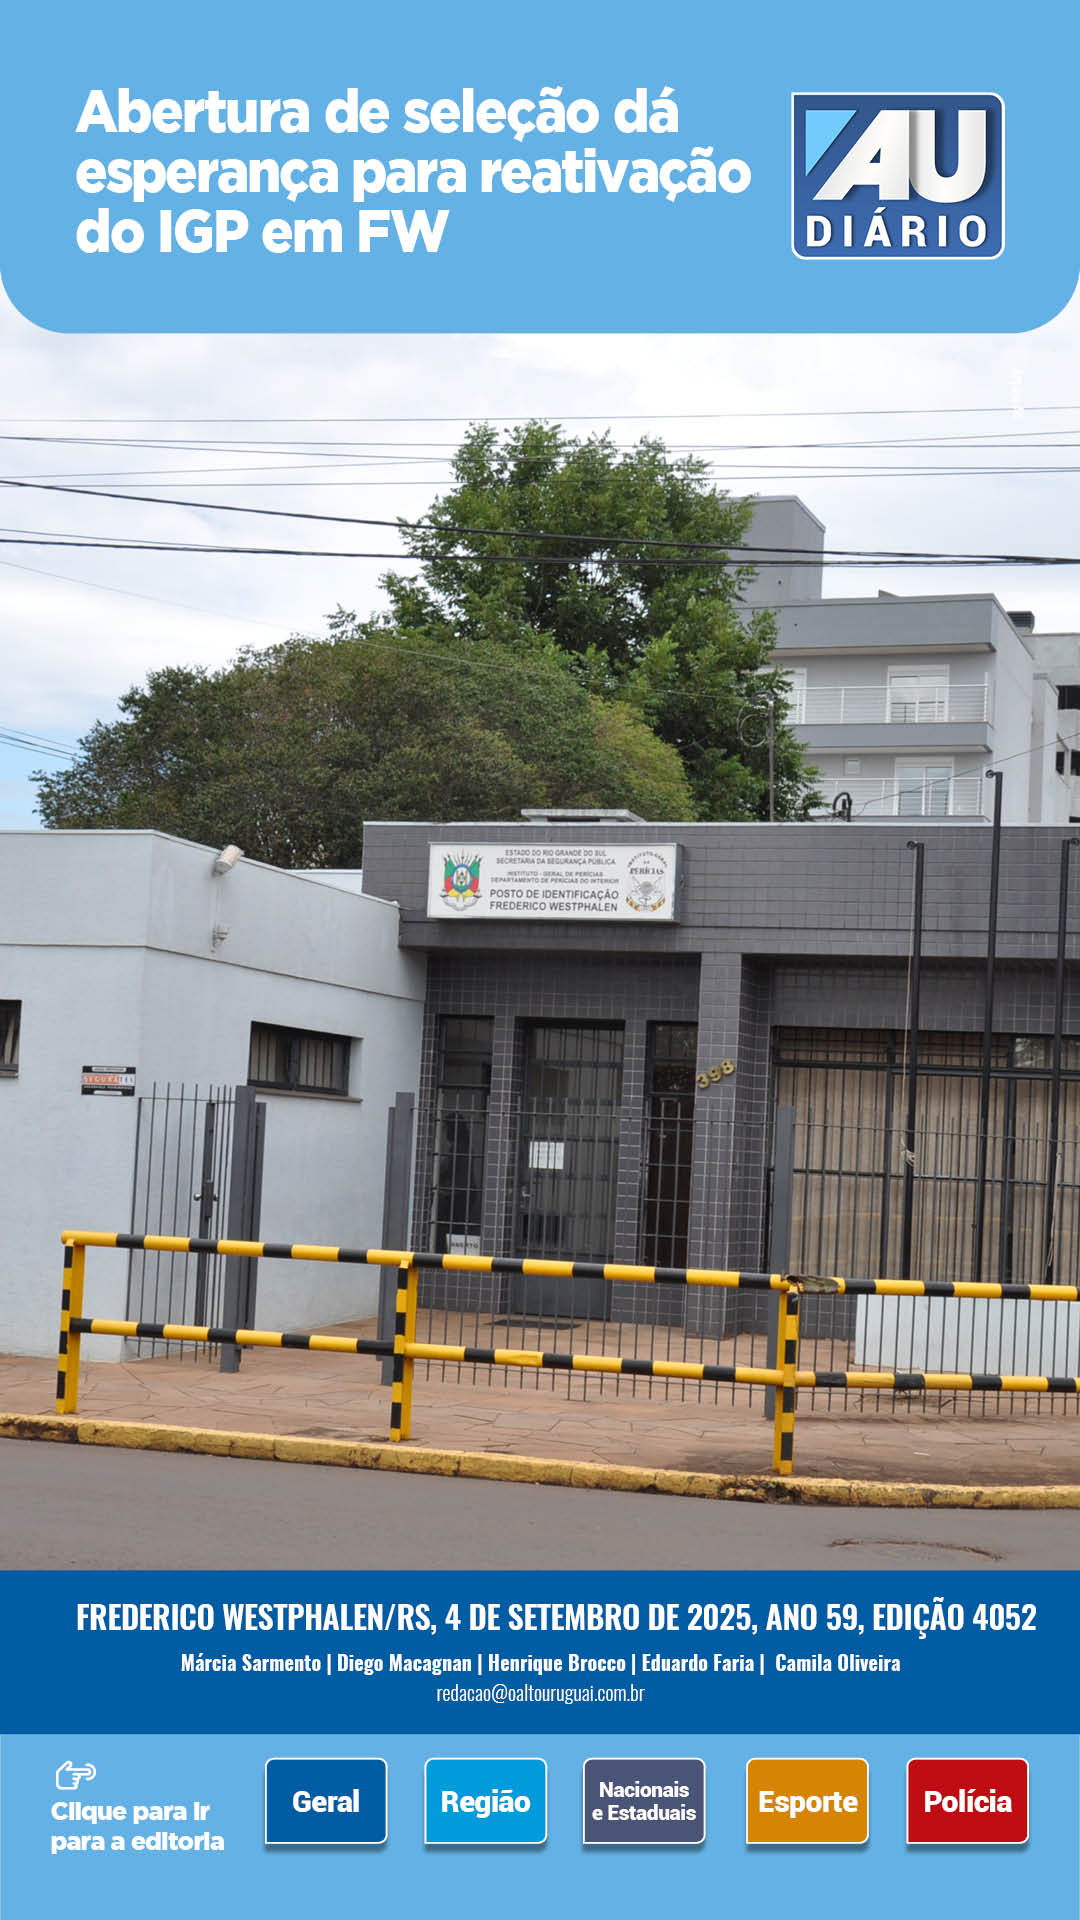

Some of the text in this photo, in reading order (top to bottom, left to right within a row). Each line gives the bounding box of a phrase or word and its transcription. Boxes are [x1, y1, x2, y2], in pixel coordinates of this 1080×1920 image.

[555, 849, 581, 857] GRANDE
[547, 858, 586, 866] SEGURANÇA
[588, 857, 616, 866] PÚBLICA
[490, 888, 619, 901] POSTO DE IDENTIFICAÇÃO
[490, 901, 618, 912] FREDERICO WESTPHALEN
[696, 1058, 735, 1089] 398
